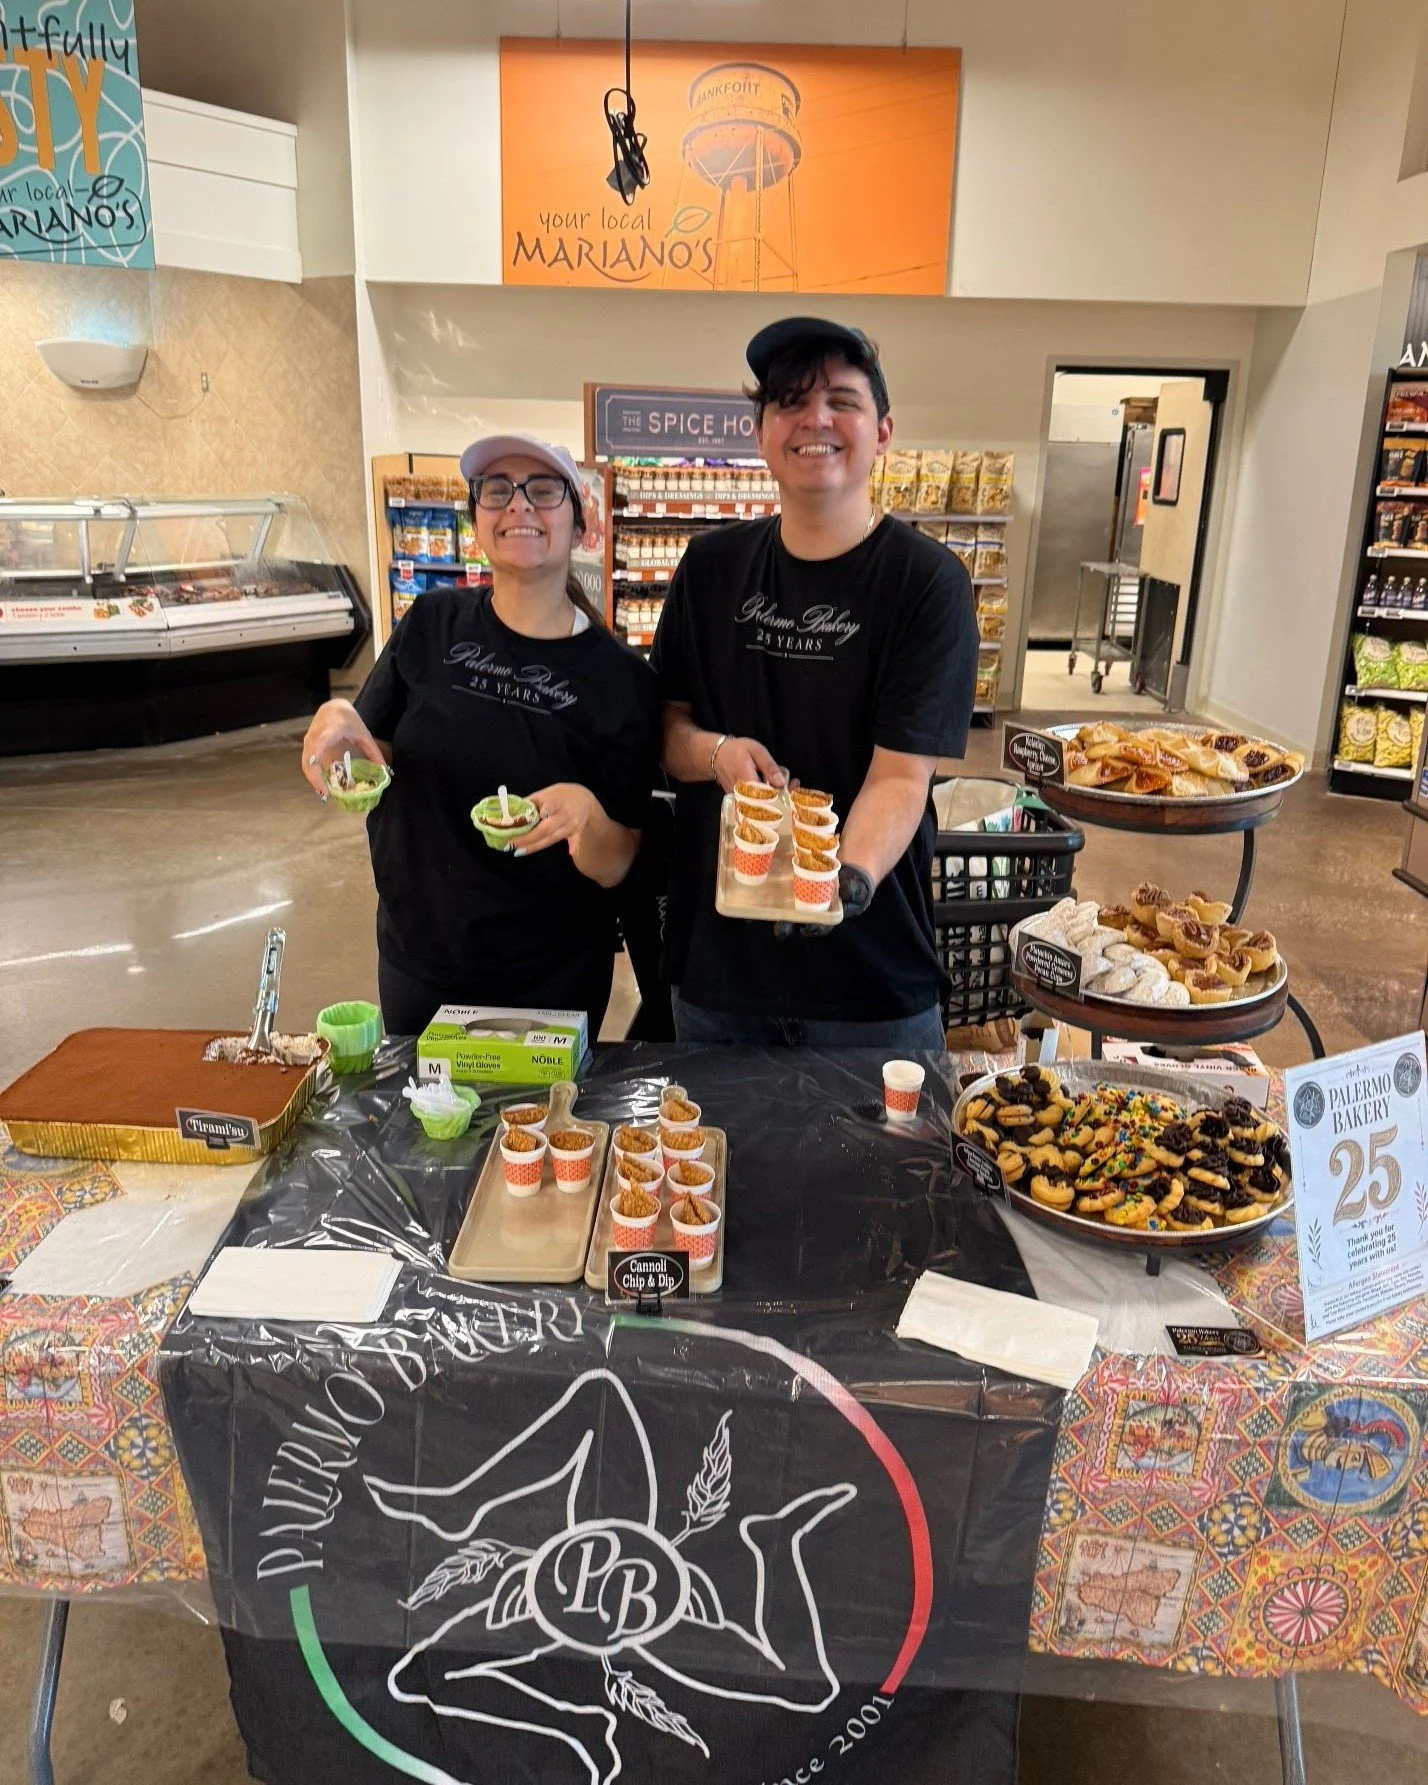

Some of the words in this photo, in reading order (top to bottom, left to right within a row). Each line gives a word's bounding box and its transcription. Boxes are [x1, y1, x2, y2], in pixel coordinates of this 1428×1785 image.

[26, 181, 74, 202] local
[539, 207, 591, 234] your
[602, 206, 651, 231] local
[513, 231, 713, 283] MARIANO'S
[622, 415, 642, 427] THE
[648, 411, 715, 435] SPICE
[796, 604, 860, 647] Bakery
[756, 628, 771, 646] 25
[777, 635, 823, 652] YEARS
[443, 641, 513, 677] Palermo
[496, 682, 540, 703] YEARS
[553, 1036, 567, 1045] M
[428, 1063, 441, 1074] M
[456, 1061, 475, 1070] Vinyl
[475, 1061, 501, 1069] Gloves
[1328, 1073, 1391, 1110] PALERMO
[1333, 1095, 1390, 1134] BAKERY
[190, 1118, 245, 1137] Tirami'su
[1329, 1124, 1402, 1227] 25
[1347, 1232, 1368, 1248] Thank
[1370, 1228, 1383, 1241] you
[1384, 1223, 1394, 1233] for
[1347, 1238, 1386, 1258] celebrating
[1387, 1232, 1396, 1243] 25
[630, 1259, 667, 1273] Cannoli
[1349, 1256, 1368, 1271] years
[1369, 1248, 1384, 1260] with
[622, 1273, 645, 1291] Chip
[647, 1274, 656, 1288] &
[658, 1274, 675, 1290] Dip
[256, 1372, 385, 1581] PALERMO
[554, 1530, 658, 1641] PB
[828, 1695, 894, 1756] 2001
